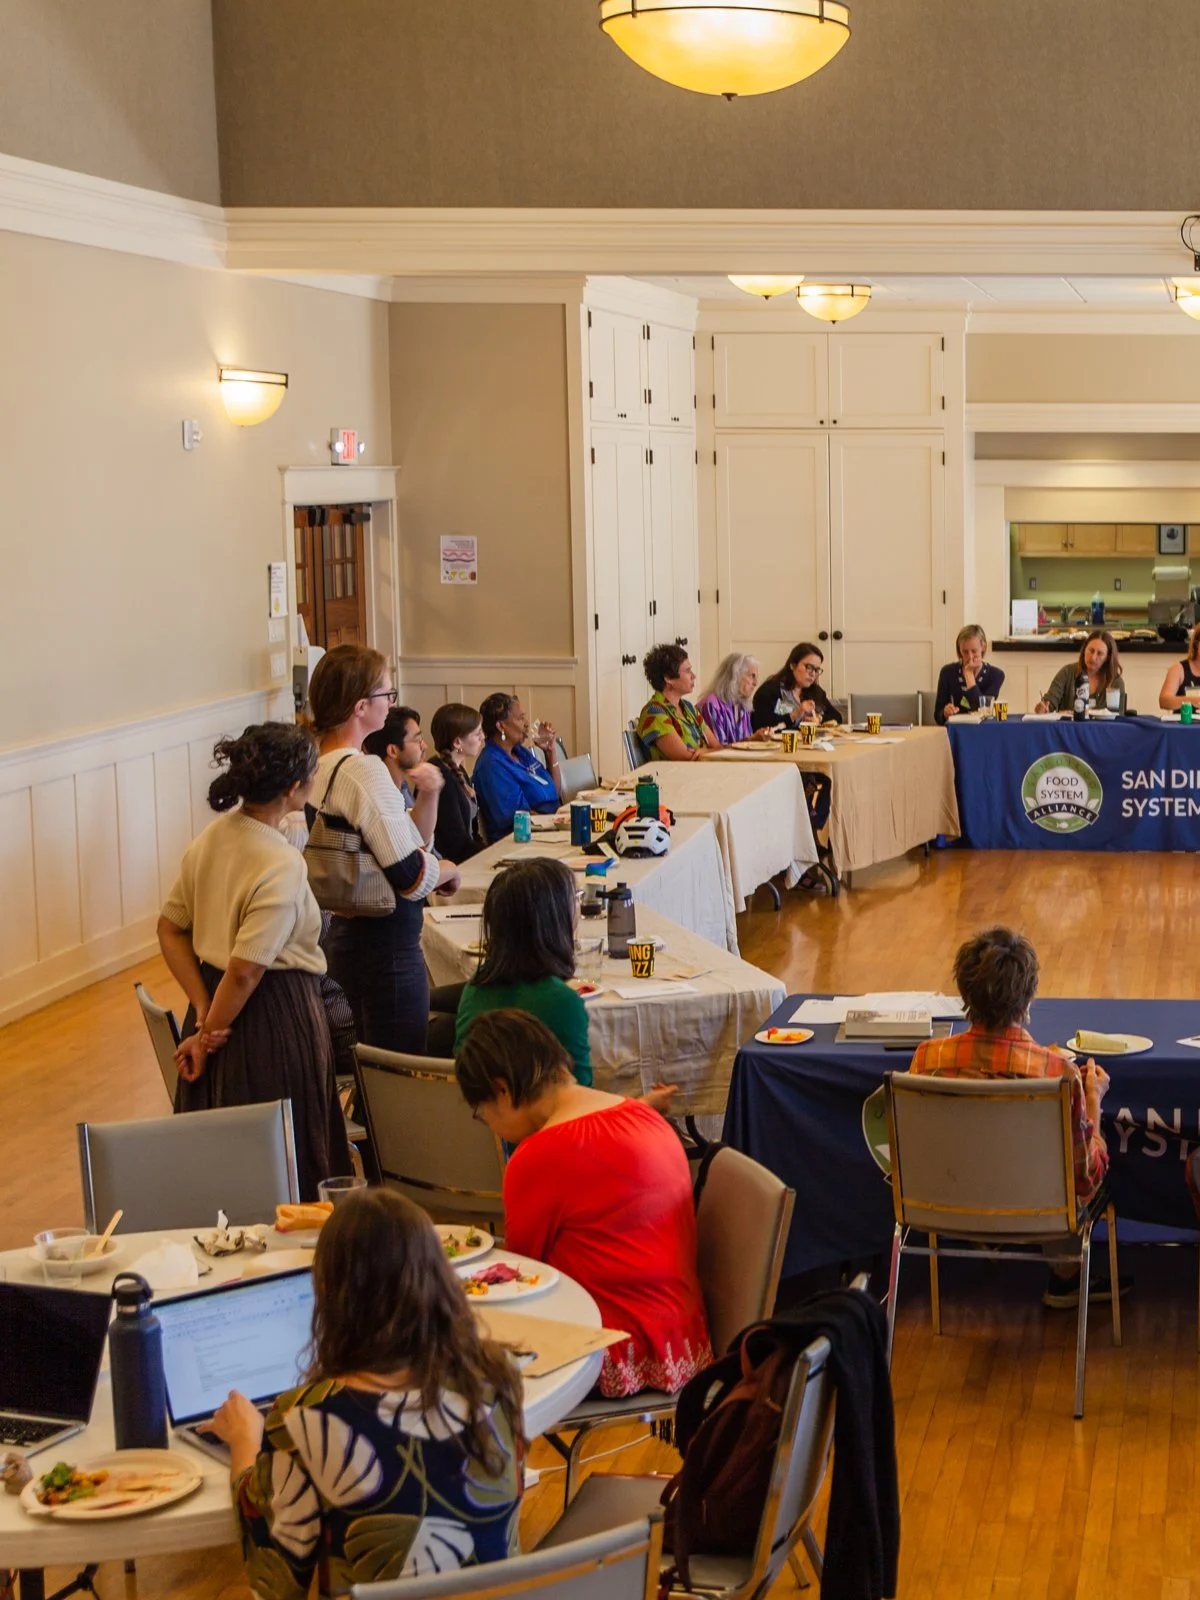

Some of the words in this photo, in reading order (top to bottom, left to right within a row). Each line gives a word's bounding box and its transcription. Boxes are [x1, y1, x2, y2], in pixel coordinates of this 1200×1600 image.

[1046, 776, 1079, 787] FOOD
[1121, 770, 1165, 790] SAN
[1041, 789, 1083, 800] SYSTEM
[1033, 803, 1093, 820] ALLIANCE
